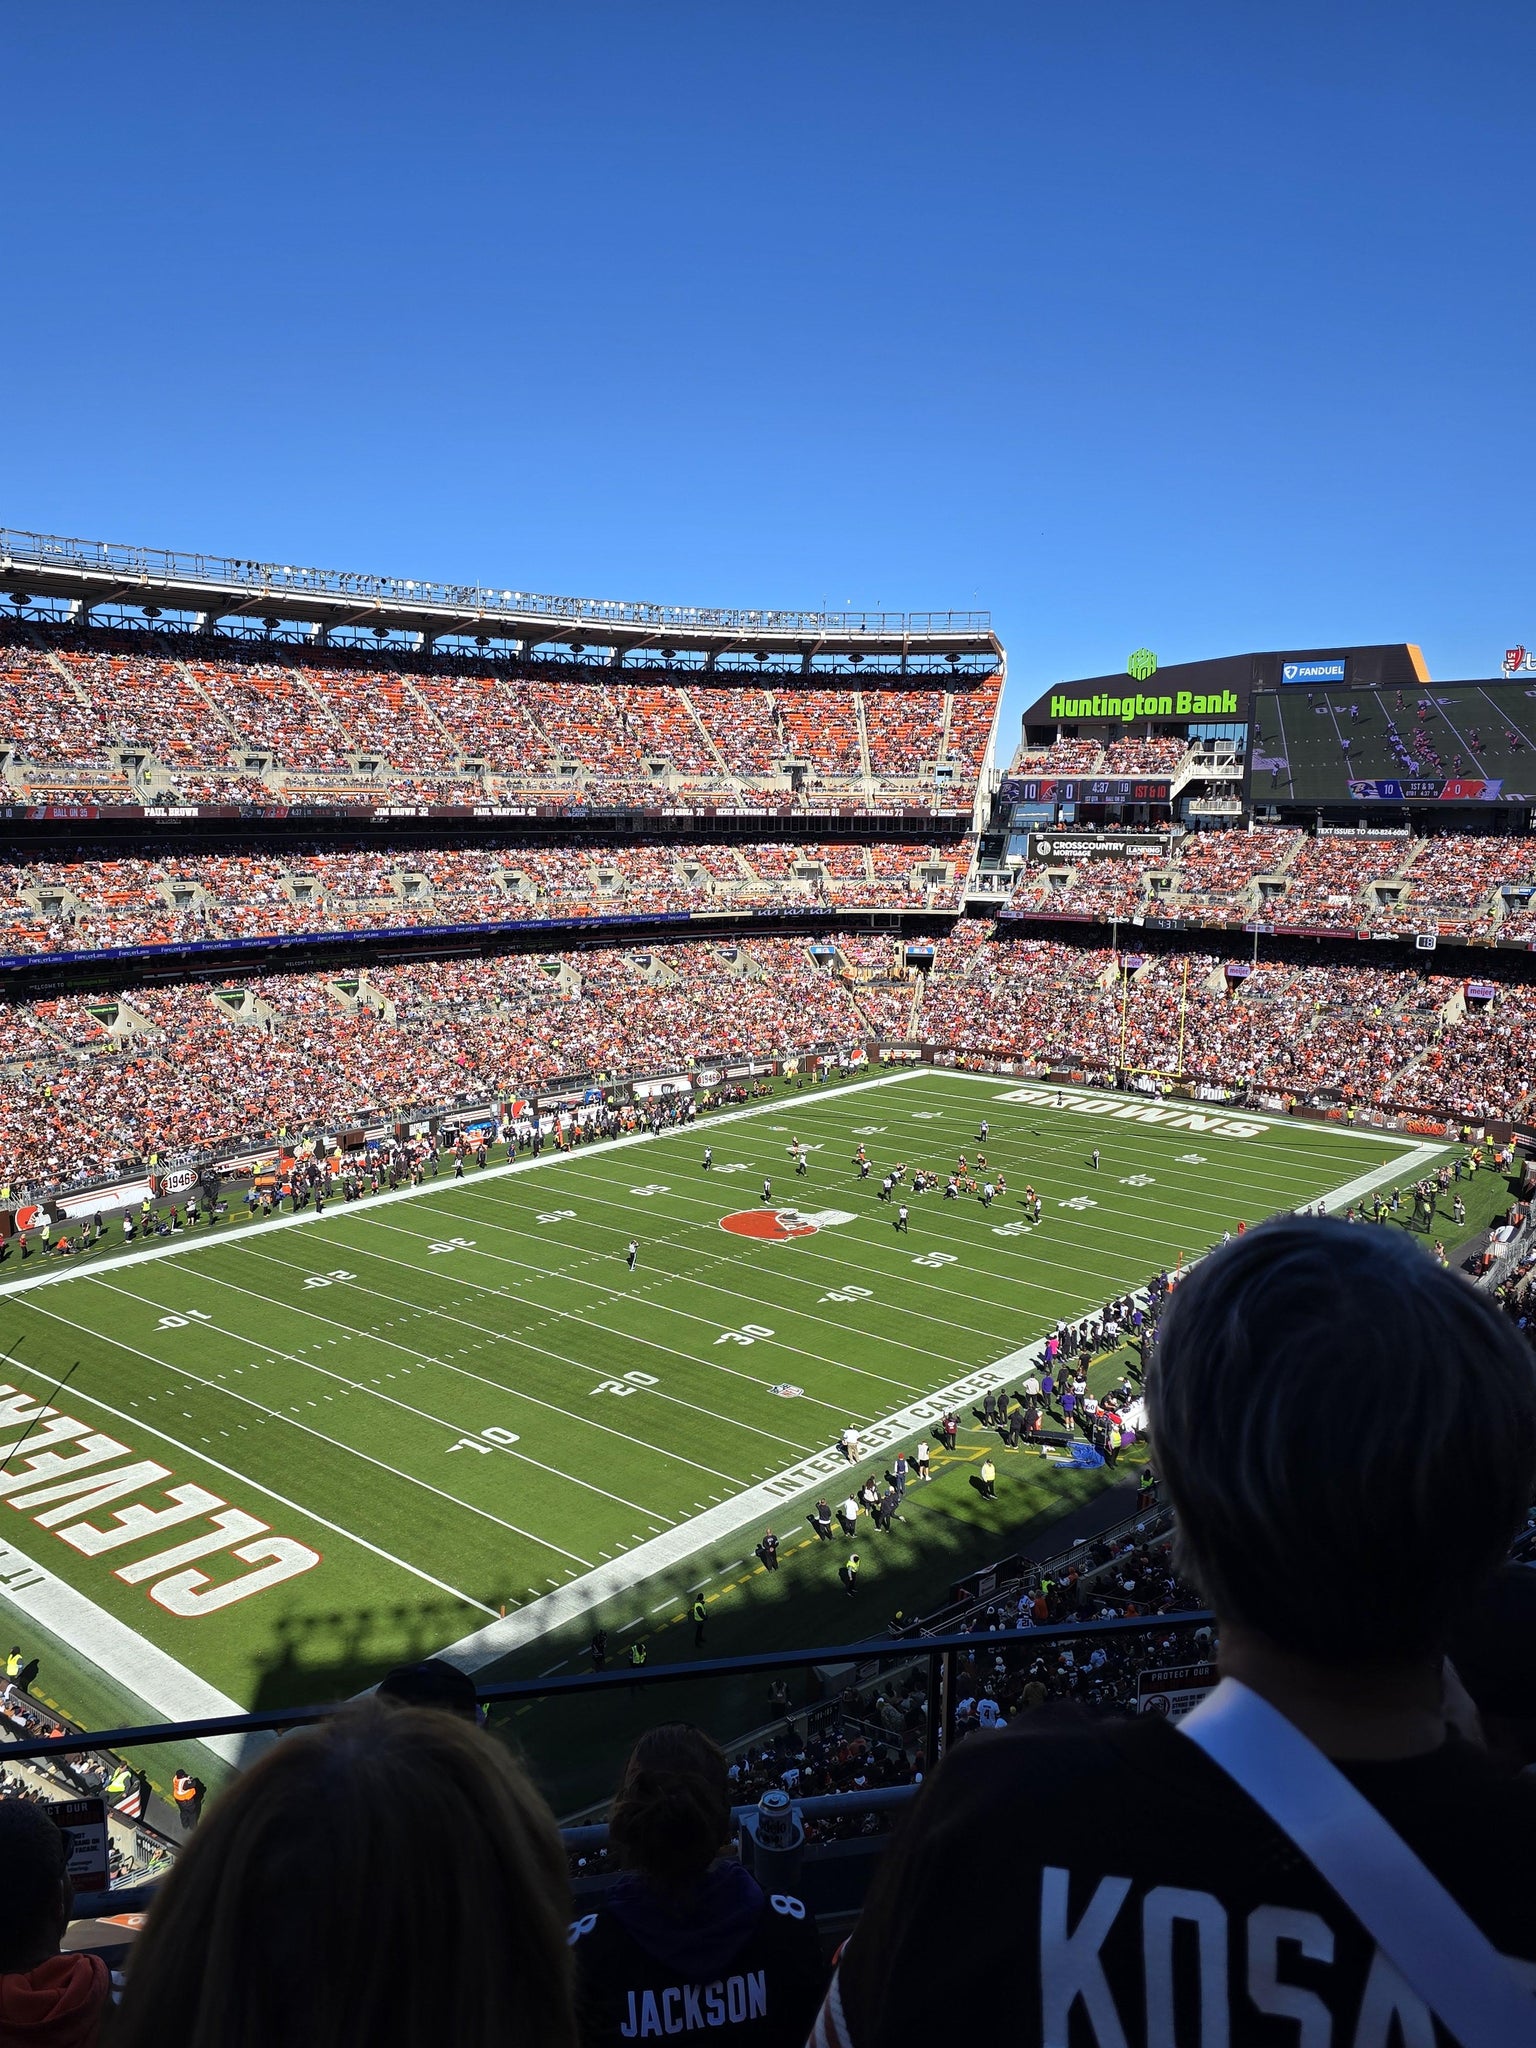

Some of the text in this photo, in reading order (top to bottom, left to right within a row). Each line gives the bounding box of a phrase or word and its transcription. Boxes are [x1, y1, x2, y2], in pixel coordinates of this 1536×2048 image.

[1299, 665, 1345, 677] FANDUEL
[1050, 689, 1238, 722] Huntington Bank
[1024, 784, 1037, 799] 10
[1092, 782, 1109, 793] 4:37
[1121, 782, 1129, 792] 19
[1135, 785, 1148, 798] 1ST
[1157, 785, 1166, 798] 10
[1384, 784, 1394, 794] 10
[1454, 784, 1461, 795] 0
[53, 808, 88, 817] BALL ON 35
[144, 807, 199, 817] PAUL BROWN
[374, 807, 429, 816] JIM BROWN 32
[473, 807, 537, 816] PAUL WARFIELD 42
[661, 808, 675, 816] LOU
[696, 808, 705, 816] 76
[735, 807, 767, 816] NEWSOME
[791, 808, 805, 816] MAC
[805, 808, 831, 816] SPEEDIE
[854, 808, 904, 817] JOE THOMAS 73
[1366, 828, 1409, 836] 440-824-6000
[1053, 841, 1125, 851] CROSSCOUNTRY
[1128, 846, 1161, 855] LANDING
[1158, 920, 1177, 929] 4:37
[1423, 937, 1434, 948] 18
[1121, 957, 1143, 968] meijer
[1229, 967, 1250, 977] meijer
[1470, 987, 1493, 998] meijer
[701, 1073, 717, 1081] 1946
[992, 1089, 1270, 1138] BROWNS
[168, 1173, 190, 1189] 1946
[629, 1183, 671, 1196] 50
[1058, 1196, 1099, 1211] 30
[536, 1209, 577, 1223] 40
[991, 1222, 1033, 1237] 40
[427, 1237, 477, 1253] 30
[912, 1251, 959, 1268] 50
[303, 1269, 358, 1288] 20
[824, 1284, 874, 1304] 40
[158, 1309, 212, 1328] 10
[720, 1323, 776, 1346] 30
[598, 1370, 660, 1397] 20
[909, 1371, 1004, 1419] CANCER
[458, 1426, 520, 1455] 10
[1151, 1667, 1210, 1682] PROTECT OUR
[66, 1802, 88, 1813] OUR
[770, 1893, 806, 1920] 8
[620, 1969, 768, 2038] JACKSON
